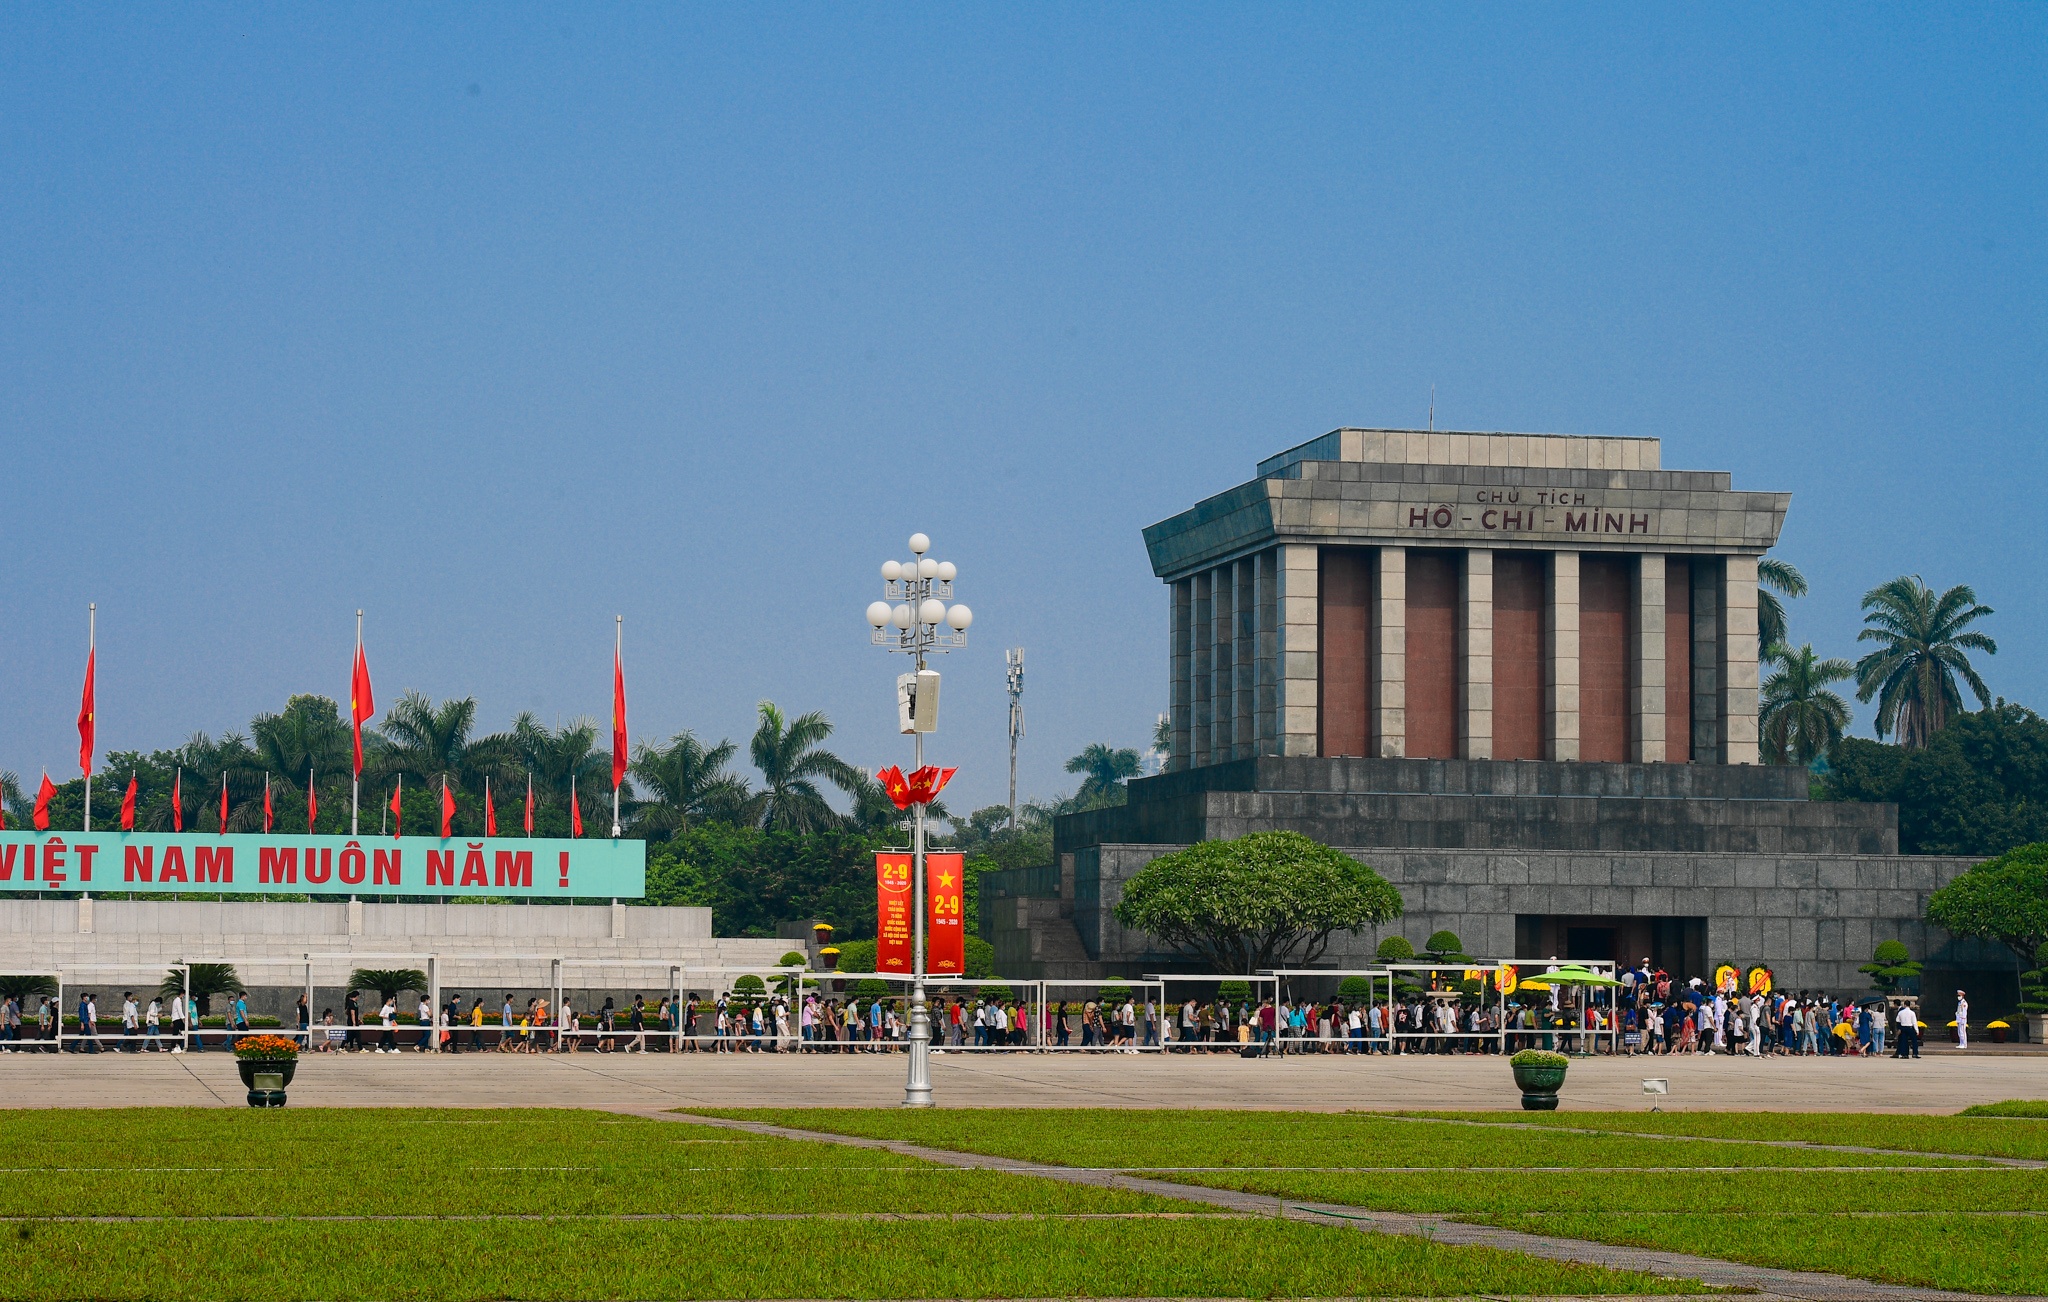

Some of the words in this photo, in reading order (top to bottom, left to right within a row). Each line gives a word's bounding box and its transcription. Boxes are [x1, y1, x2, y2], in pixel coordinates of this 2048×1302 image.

[1476, 486, 1520, 503] CHỦ
[1409, 503, 1455, 528] HỒ
[1481, 505, 1538, 531] CHÍ
[0, 837, 99, 888] VIỆT
[125, 846, 233, 883] NAM
[259, 841, 401, 885] MUÔN
[427, 842, 533, 887] NĂM
[883, 863, 908, 880] 2-9
[934, 894, 959, 915] 2-9
